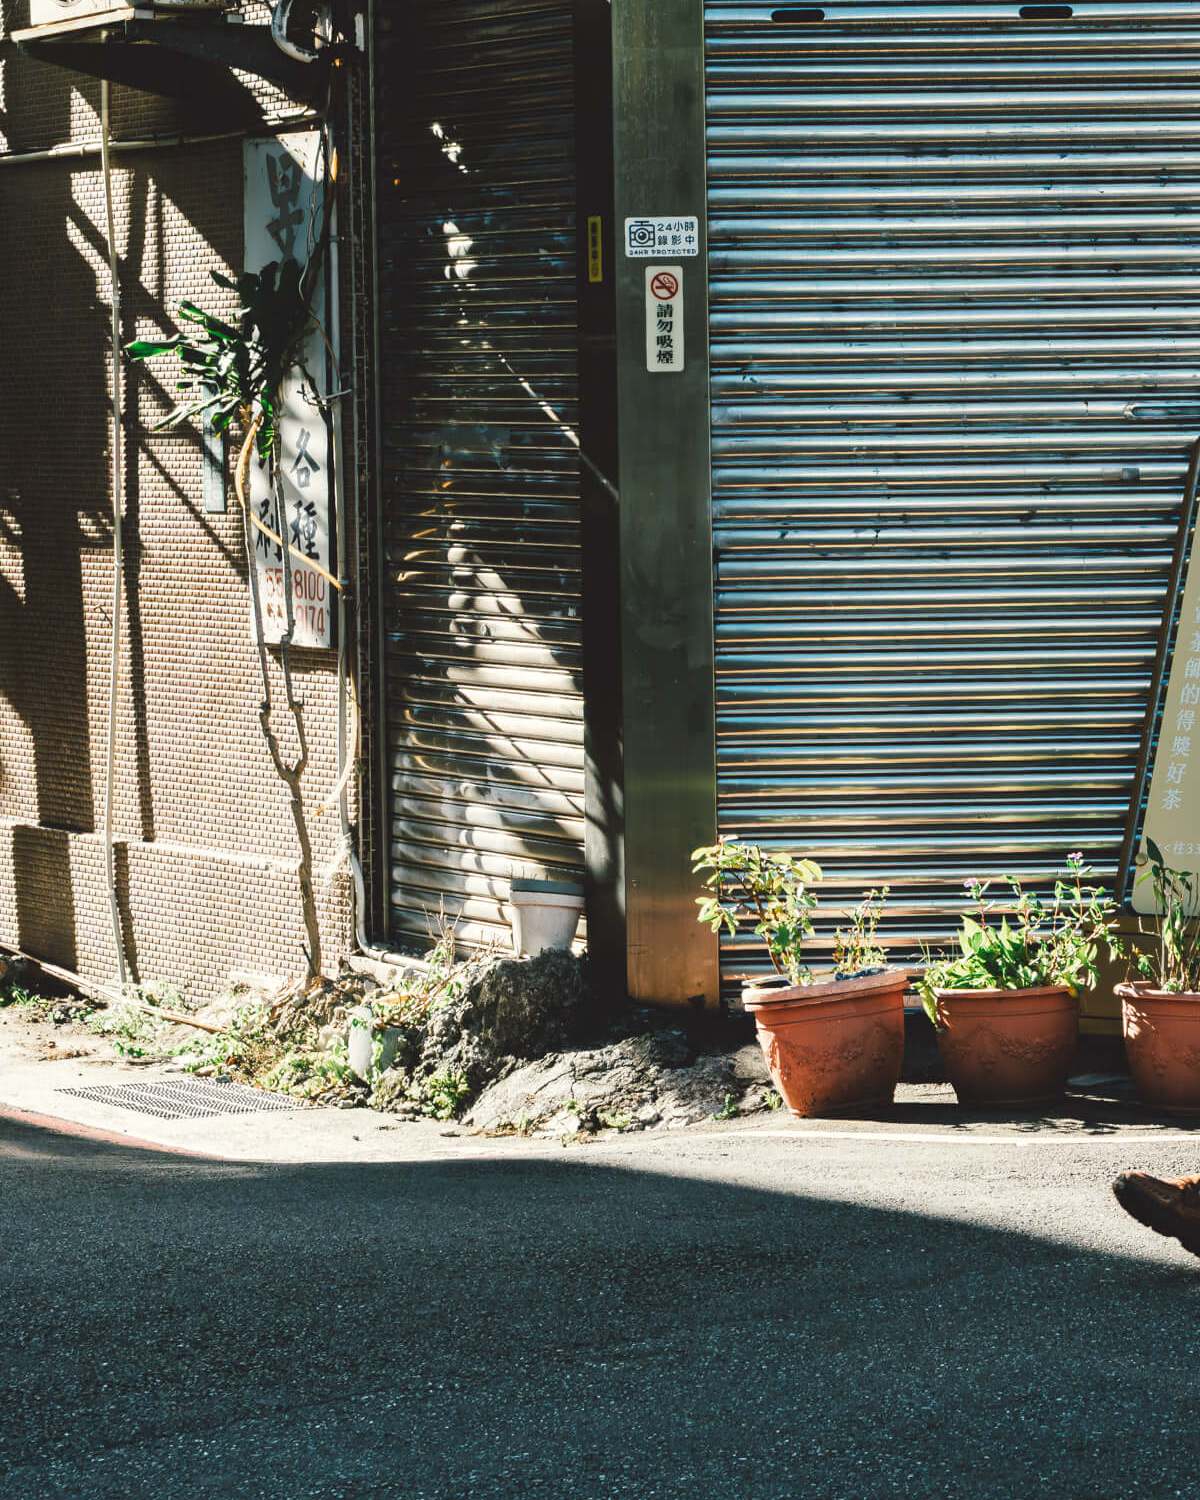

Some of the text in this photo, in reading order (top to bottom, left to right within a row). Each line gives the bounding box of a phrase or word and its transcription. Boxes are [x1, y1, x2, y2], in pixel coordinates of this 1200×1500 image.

[657, 221, 695, 232] 24小時
[656, 303, 674, 364] 請勿吸煙
